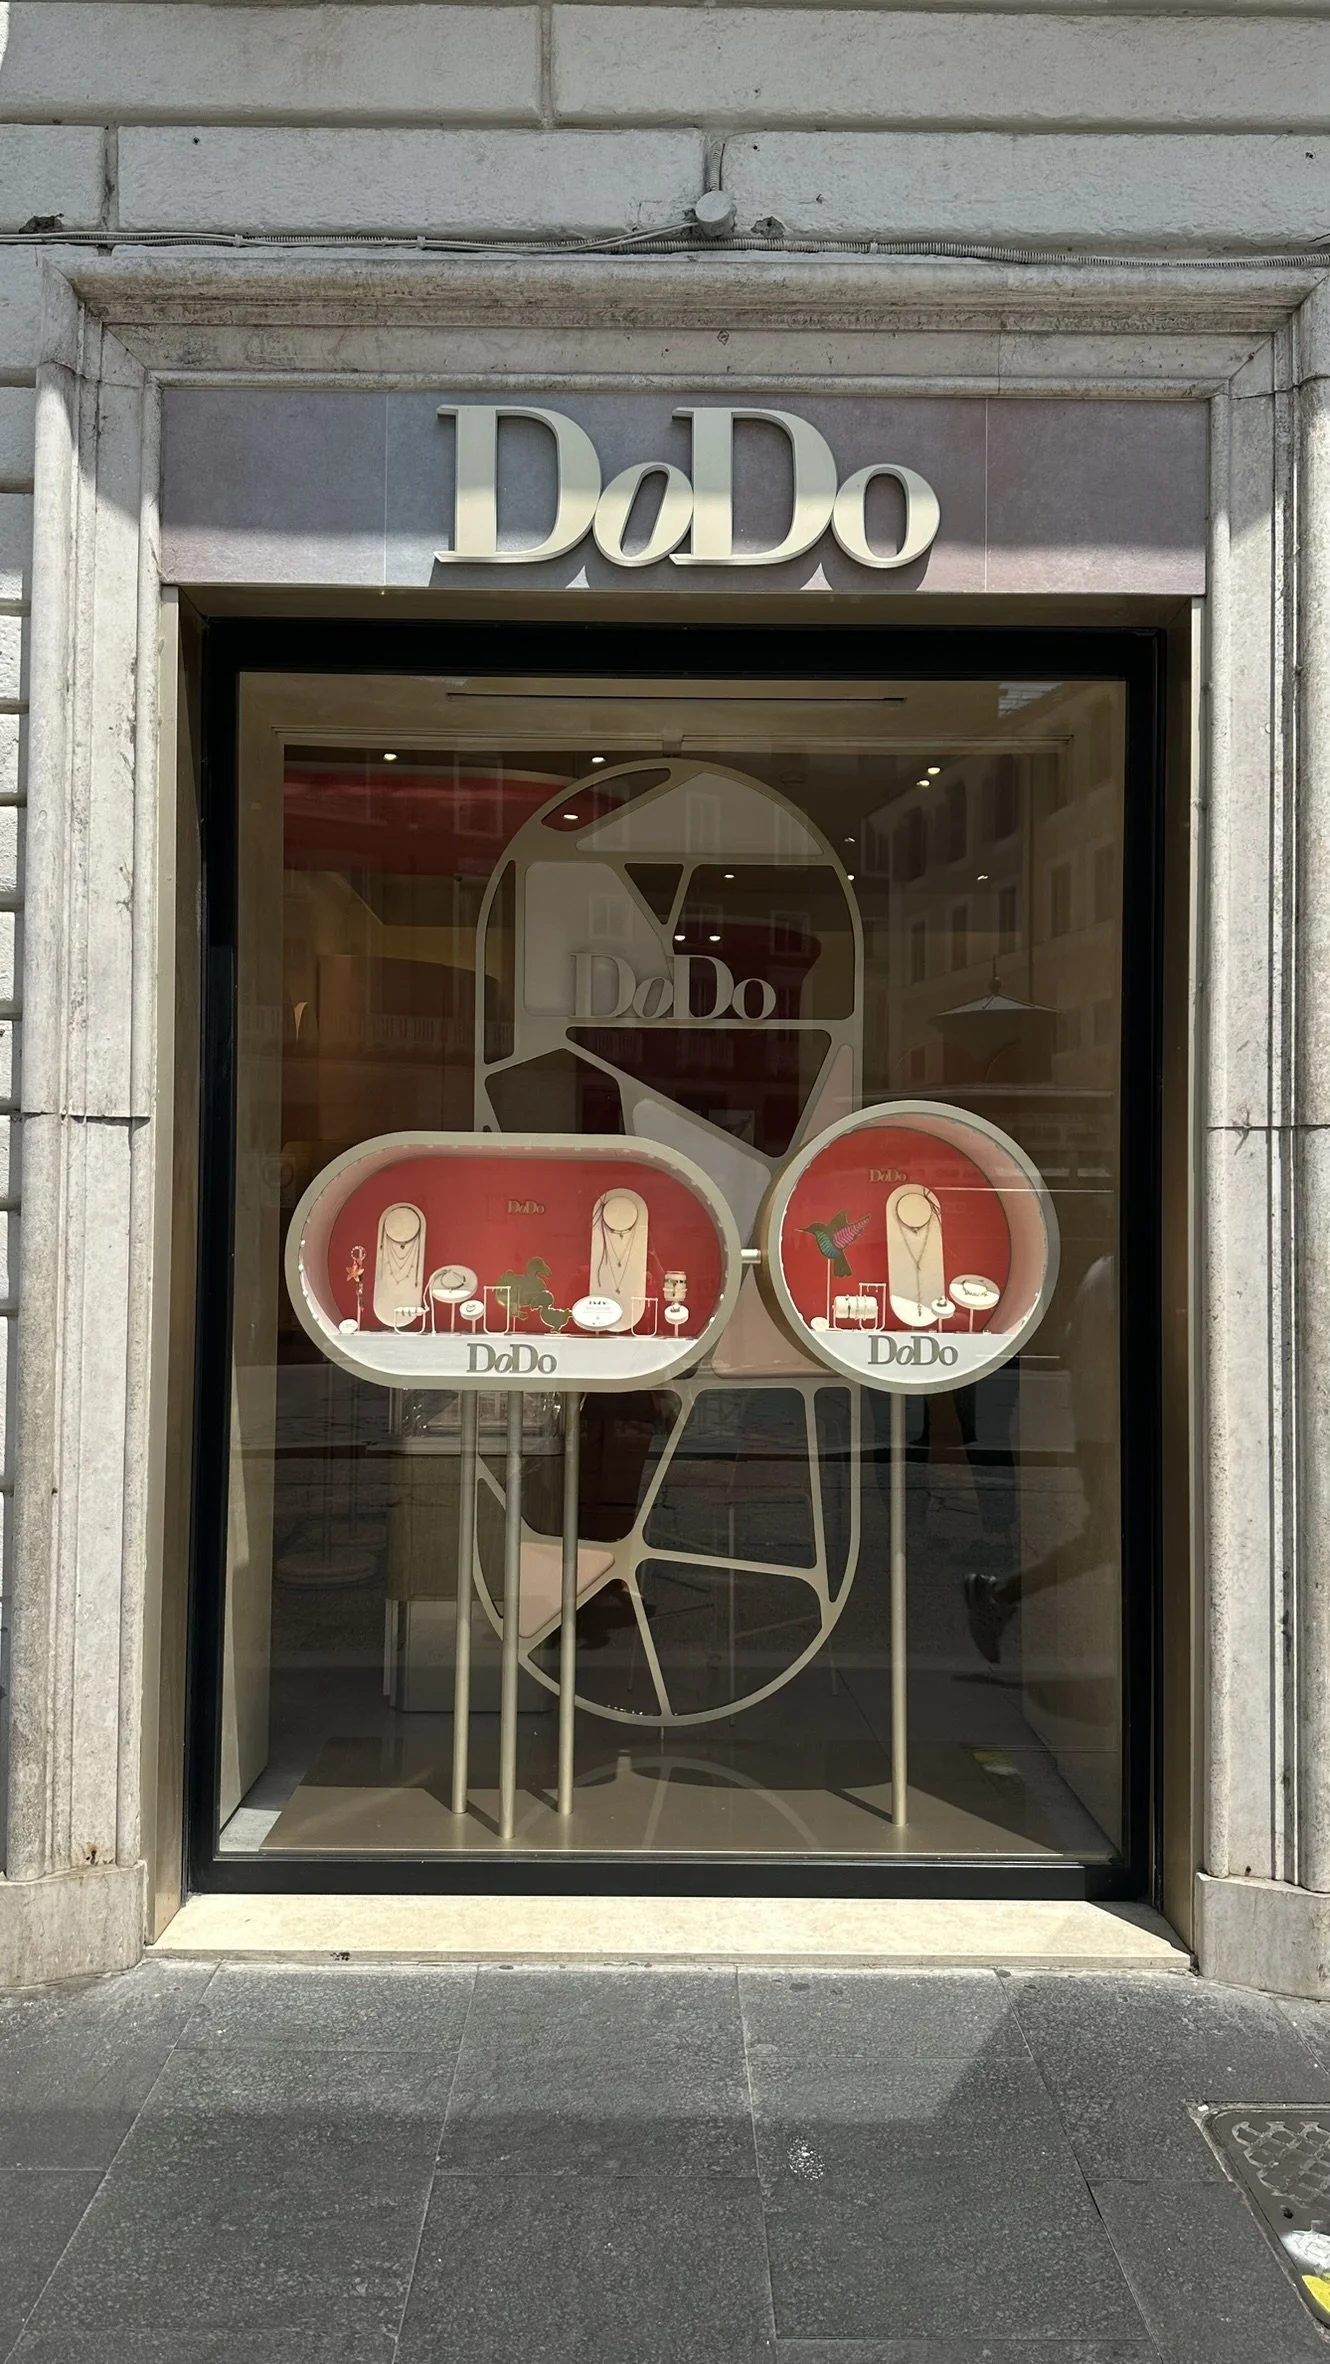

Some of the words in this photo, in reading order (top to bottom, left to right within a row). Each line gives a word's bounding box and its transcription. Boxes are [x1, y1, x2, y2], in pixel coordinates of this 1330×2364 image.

[433, 405, 941, 568] DoDo
[568, 952, 776, 1020] DoDo
[868, 1168, 908, 1182] DoDo
[507, 1199, 546, 1214] DoDo
[466, 1343, 557, 1374] DoDo
[867, 1335, 959, 1366] DoDo
